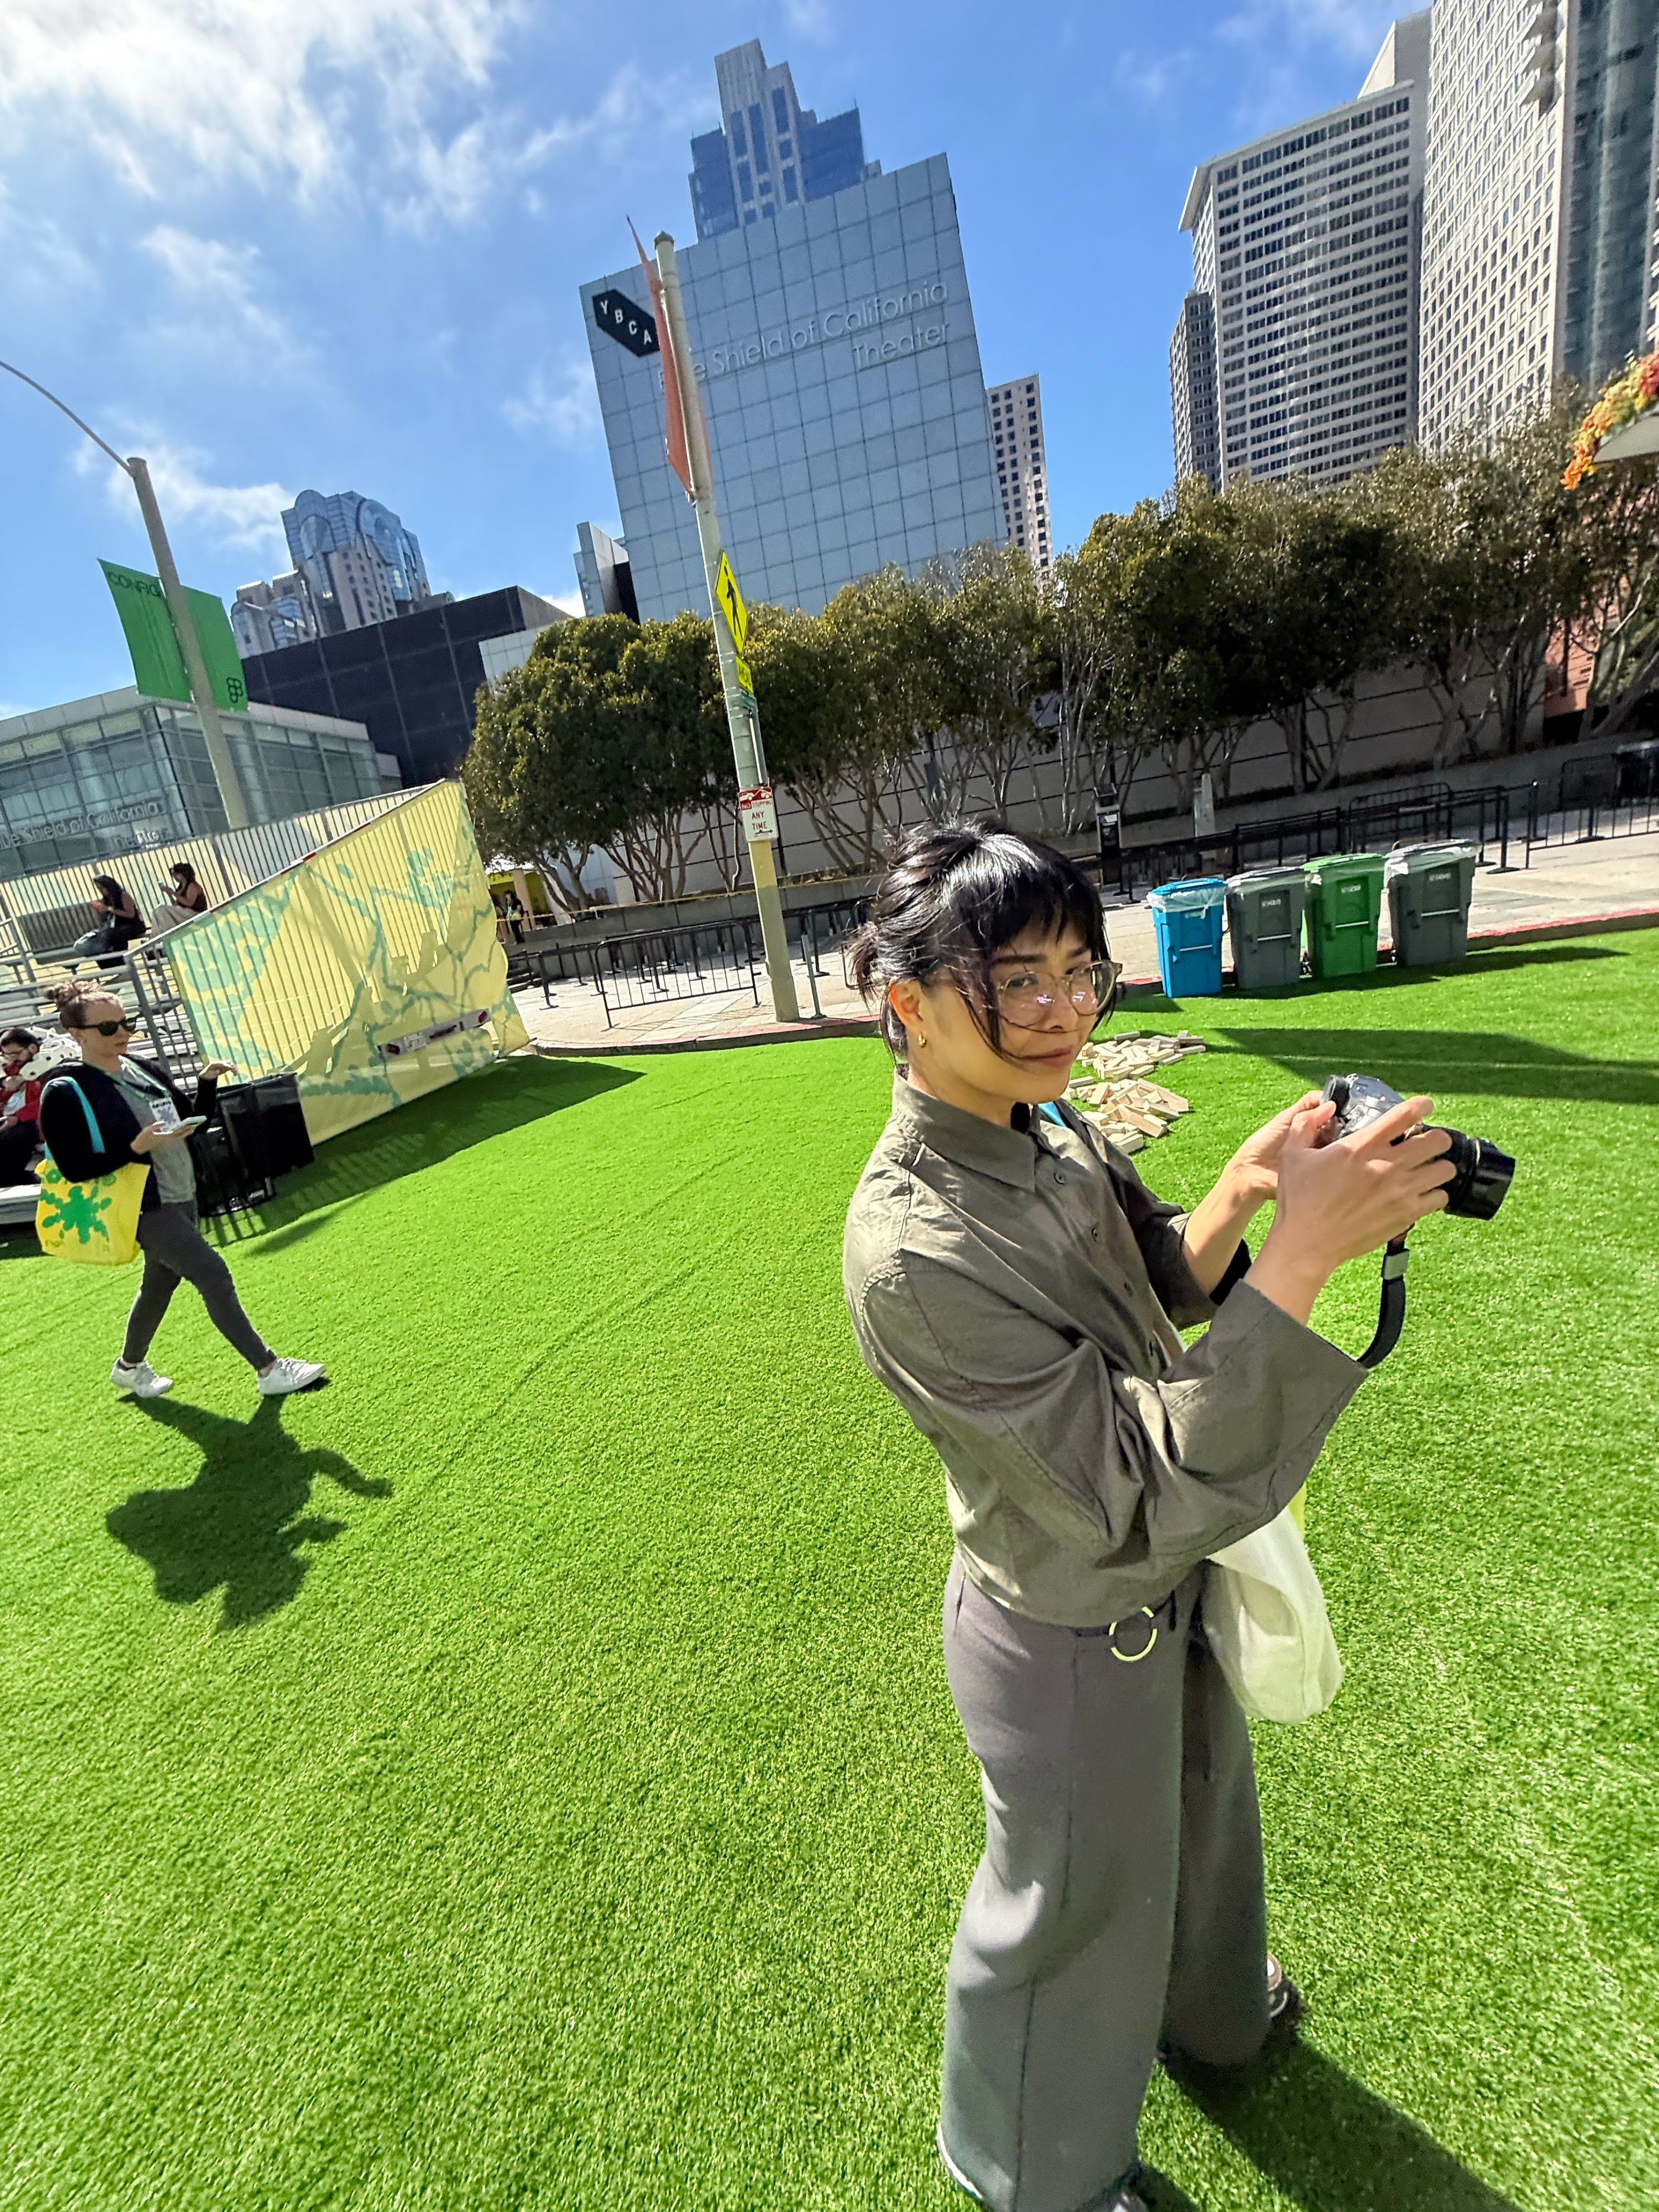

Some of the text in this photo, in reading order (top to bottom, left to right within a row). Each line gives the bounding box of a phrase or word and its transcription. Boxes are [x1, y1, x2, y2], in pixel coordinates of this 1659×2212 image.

[600, 299, 652, 345] YBCA
[713, 280, 947, 374] Shield of California
[853, 324, 950, 368] Theater
[87, 800, 165, 828] California
[752, 811, 764, 820] ANY
[752, 821, 767, 830] TIME
